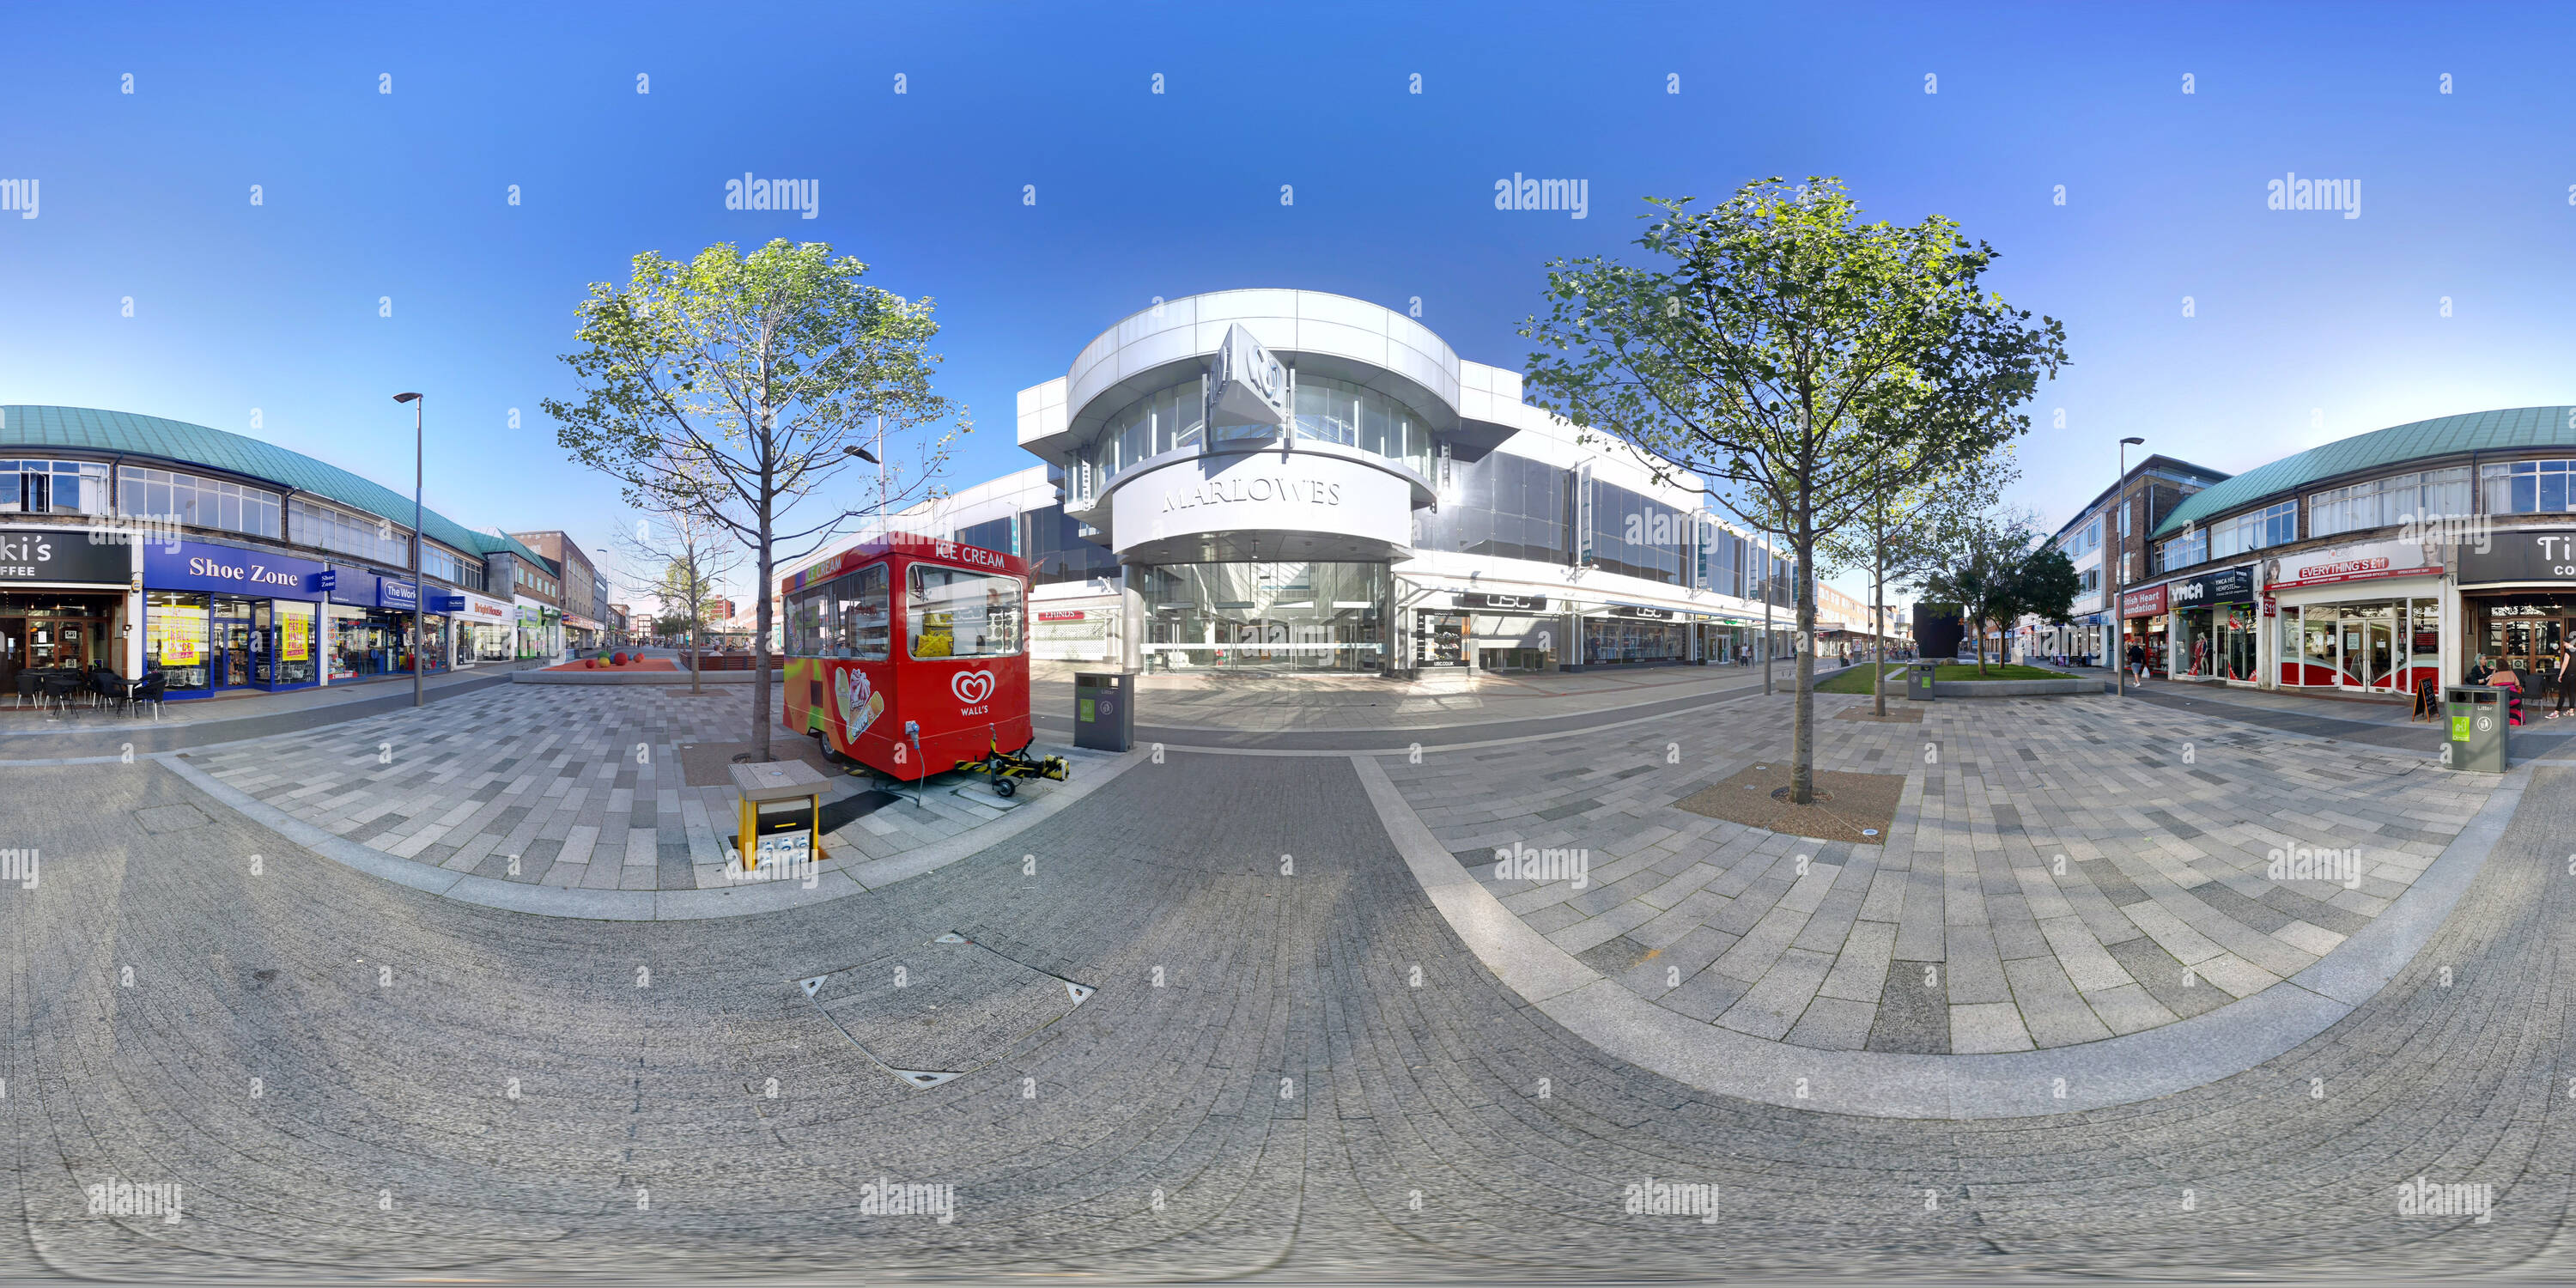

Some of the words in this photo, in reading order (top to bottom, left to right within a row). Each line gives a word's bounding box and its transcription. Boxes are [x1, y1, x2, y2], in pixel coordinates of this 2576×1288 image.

[1163, 478, 1340, 513] MARLOWES
[936, 541, 957, 560] ICE
[963, 546, 1005, 568] CREAM
[2537, 536, 2570, 561] Ti
[190, 557, 245, 580] Shoe
[251, 565, 298, 586] Zone
[805, 565, 816, 580] ICE
[816, 556, 841, 577] CREAM
[2302, 561, 2370, 578] EVERYTHING'S
[2371, 558, 2385, 569] £11
[388, 586, 399, 596] The
[400, 588, 416, 598] Work
[2140, 591, 2160, 602] Heart
[2172, 582, 2203, 602] YMCA
[475, 602, 502, 617] BrightHouse
[2124, 602, 2157, 615] oundation
[2264, 604, 2275, 614] £11
[961, 705, 988, 716] WALL'S
